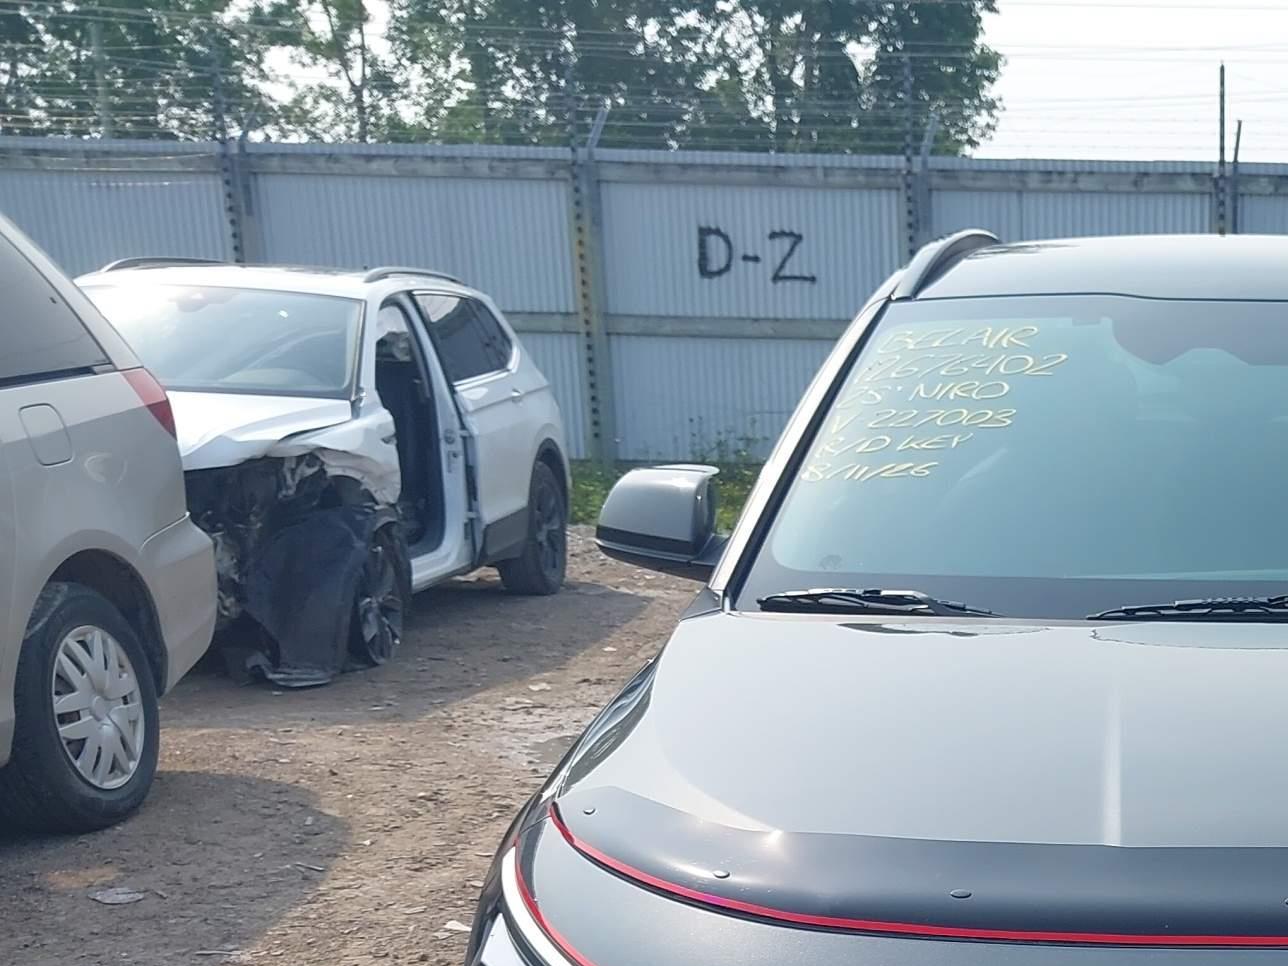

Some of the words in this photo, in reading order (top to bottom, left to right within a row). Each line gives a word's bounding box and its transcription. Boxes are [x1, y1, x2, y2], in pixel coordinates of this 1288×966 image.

[908, 381, 1010, 401] NIRO
[867, 408, 1016, 429] 227003
[896, 432, 974, 452] KEY
